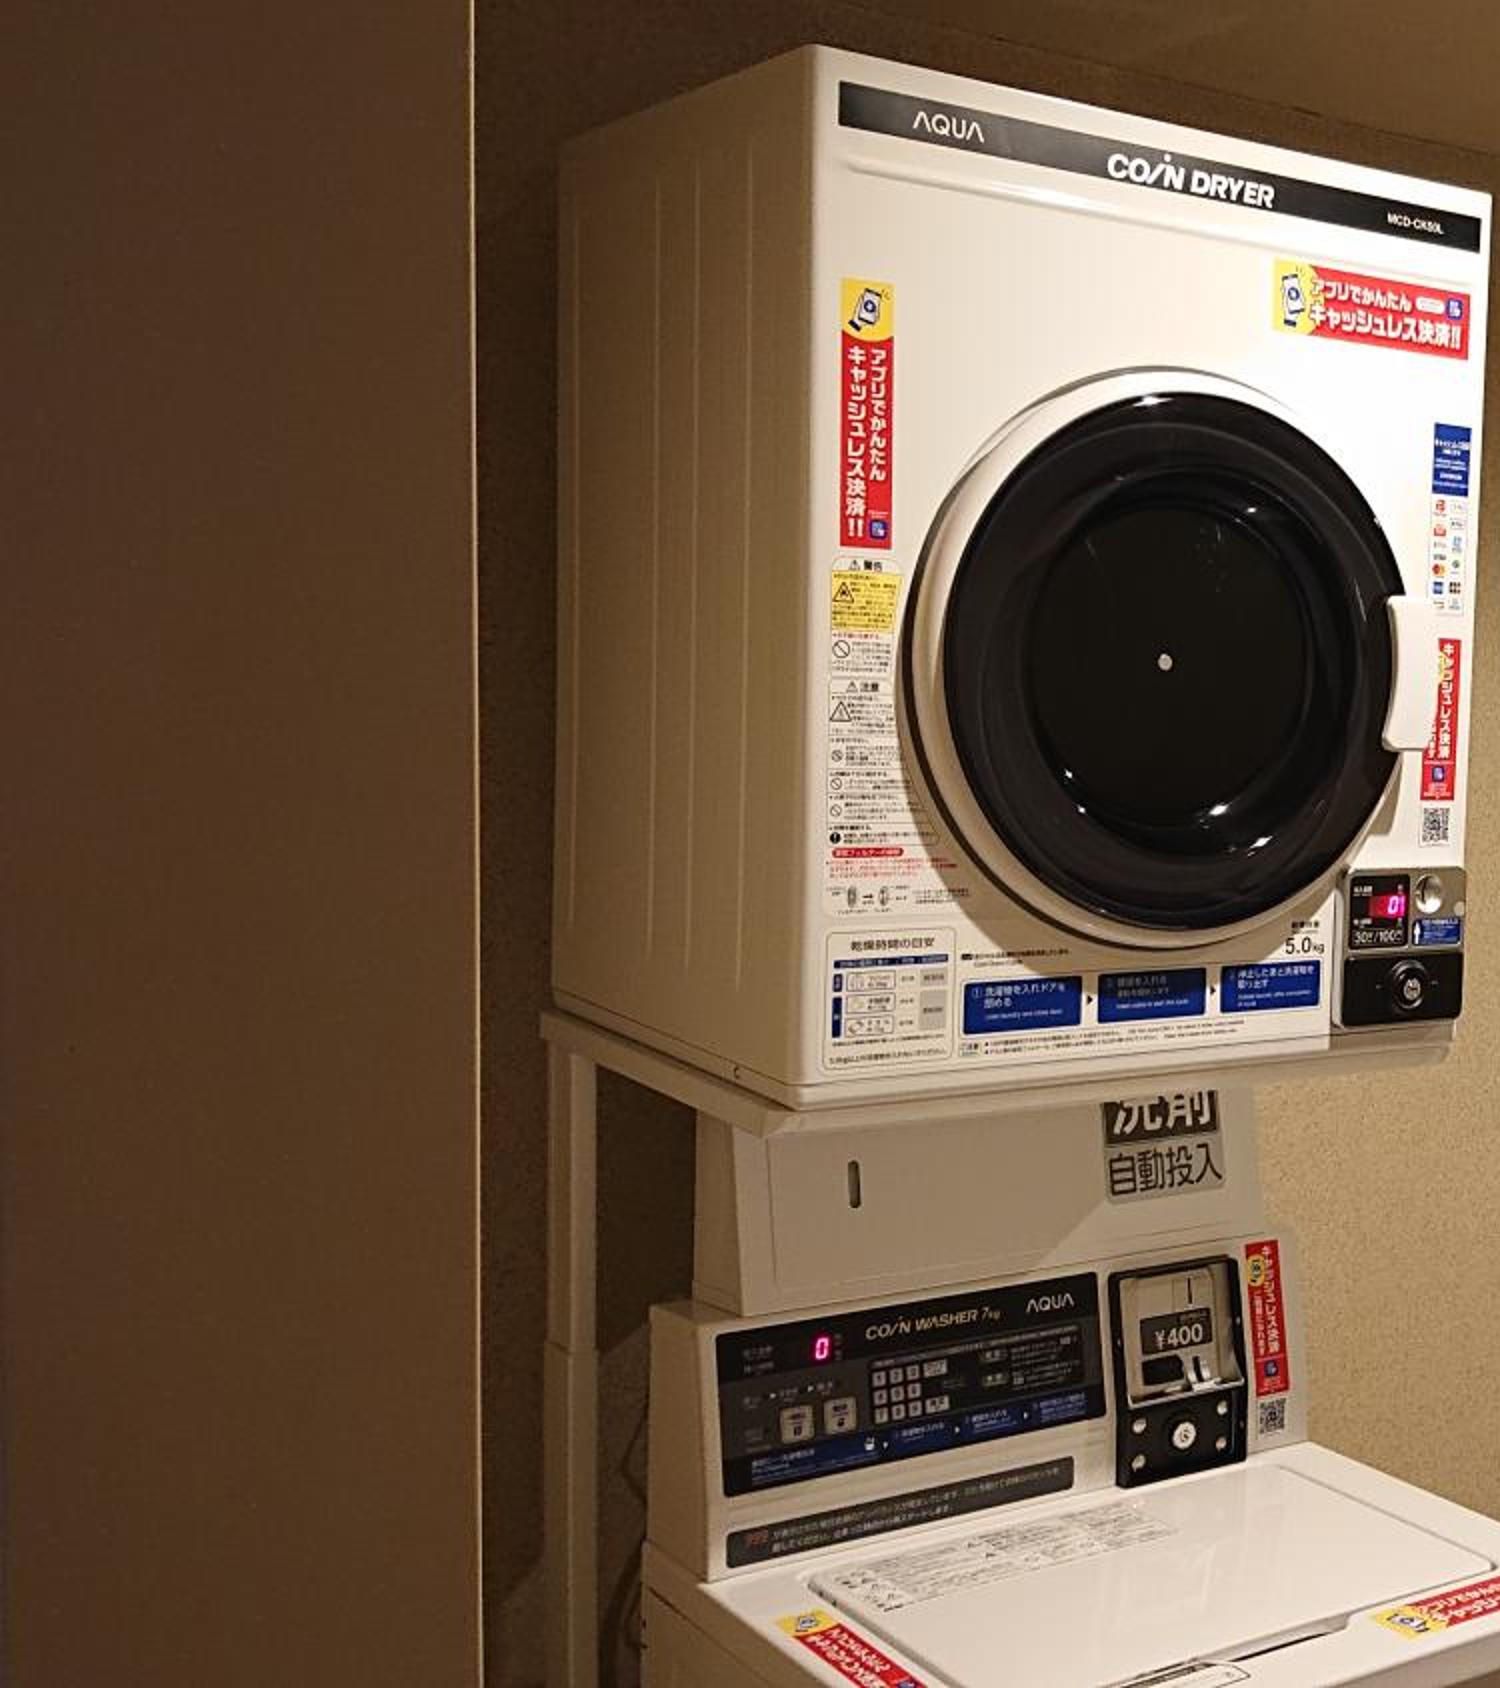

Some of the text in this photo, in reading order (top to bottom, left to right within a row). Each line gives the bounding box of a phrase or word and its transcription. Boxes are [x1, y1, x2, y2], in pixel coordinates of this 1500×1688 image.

[911, 110, 985, 144] AQUA
[1106, 153, 1275, 210] COIN DRYER
[1311, 279, 1413, 313] アプリでかんたん
[869, 348, 887, 482] アプリでかんたん
[1109, 1143, 1222, 1196] 自動投入
[916, 1308, 978, 1332] WASHER
[1026, 1292, 1075, 1314] AQUA
[815, 1337, 829, 1360] 0
[1155, 1323, 1204, 1349] ¥400
